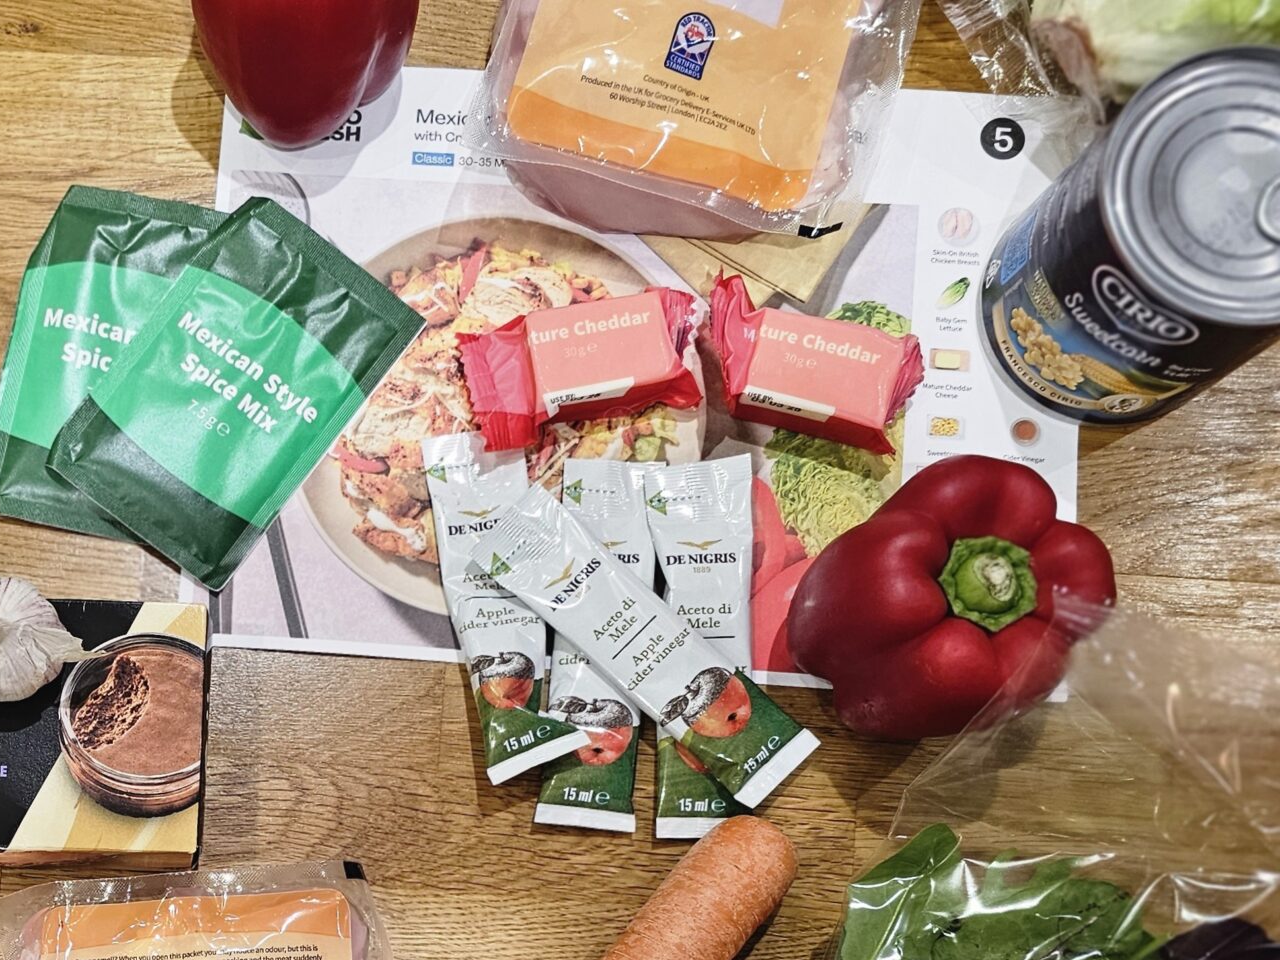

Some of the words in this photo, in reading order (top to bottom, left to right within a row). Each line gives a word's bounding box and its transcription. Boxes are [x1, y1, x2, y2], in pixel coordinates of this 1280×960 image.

[643, 75, 669, 89] Country
[581, 75, 613, 88] Produced
[655, 91, 680, 105] Grocery
[745, 125, 756, 136] LTD
[618, 94, 646, 109] Worship
[414, 131, 442, 143] with
[995, 127, 1014, 152] 5
[414, 153, 453, 165] Classic
[458, 156, 492, 168] 30-35
[1102, 275, 1187, 341] CIRIO
[573, 311, 651, 336] Cheddar
[939, 325, 963, 334] Lettuce
[1064, 290, 1163, 368] Sweetcorn
[60, 342, 113, 373] Spic
[802, 333, 882, 366] Cheddar
[177, 311, 264, 381] Mexican
[262, 374, 318, 424] Style
[180, 352, 239, 401] Spice
[237, 393, 278, 434] Mix
[935, 391, 958, 401] Cheese
[448, 525, 467, 536] DE
[666, 555, 685, 566] DE
[687, 552, 736, 564] NIGRIS
[563, 557, 601, 595] NIGRIS
[476, 607, 515, 621] Apple
[676, 604, 715, 616] Aceto
[718, 603, 733, 615] di
[459, 619, 489, 634] cider
[492, 614, 541, 627] vinegar
[608, 615, 638, 643] Mele
[686, 617, 721, 629] Mele
[631, 633, 665, 667] Apple
[627, 662, 655, 692] cider
[652, 627, 690, 664] vinegar
[504, 737, 519, 752] 15
[743, 757, 758, 774] 15
[679, 799, 694, 812] 15
[696, 798, 709, 812] ml
